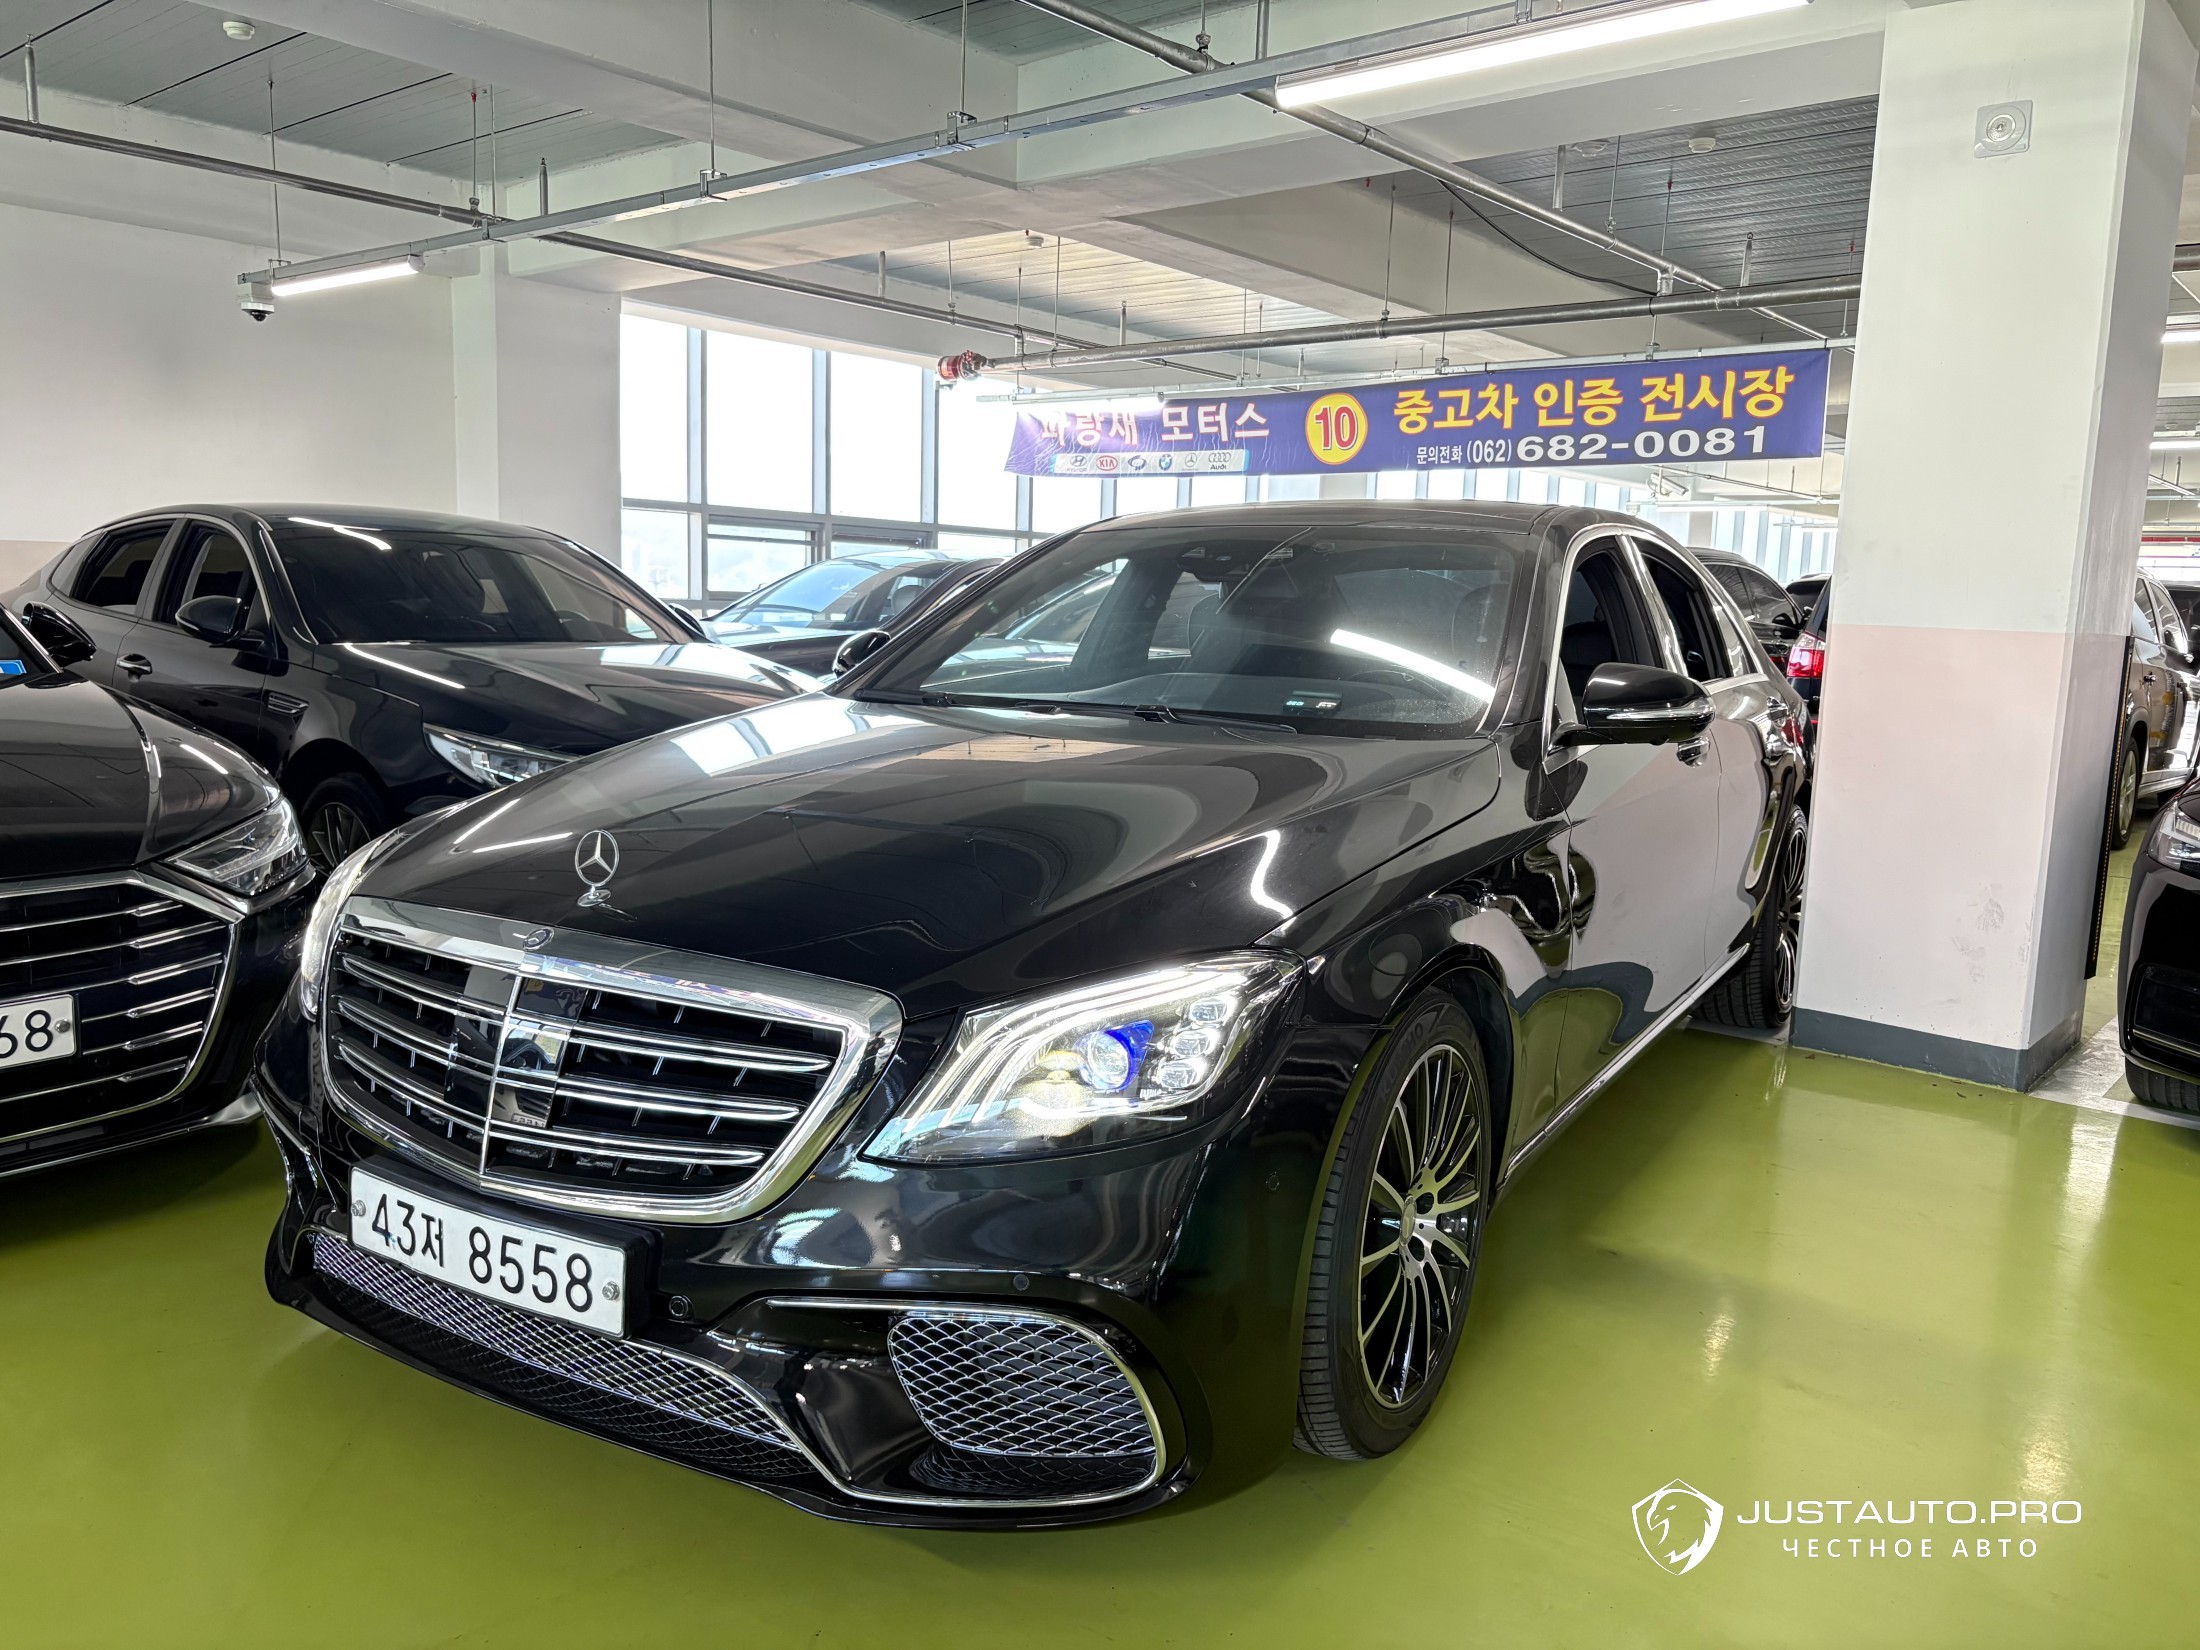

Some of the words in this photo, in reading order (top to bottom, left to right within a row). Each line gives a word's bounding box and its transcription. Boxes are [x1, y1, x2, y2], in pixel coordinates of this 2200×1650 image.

[1161, 402, 1270, 442] 모터스
[1394, 383, 1519, 434] 중고차
[1534, 376, 1624, 427] 인증
[1640, 365, 1795, 422] 전시장
[1315, 405, 1359, 450] 10
[1416, 444, 1463, 464] 문의전화
[1466, 439, 1512, 463] (062)
[1516, 425, 1766, 461] 682-0081
[371, 1193, 445, 1268] 43저
[469, 1226, 593, 1312] 8558
